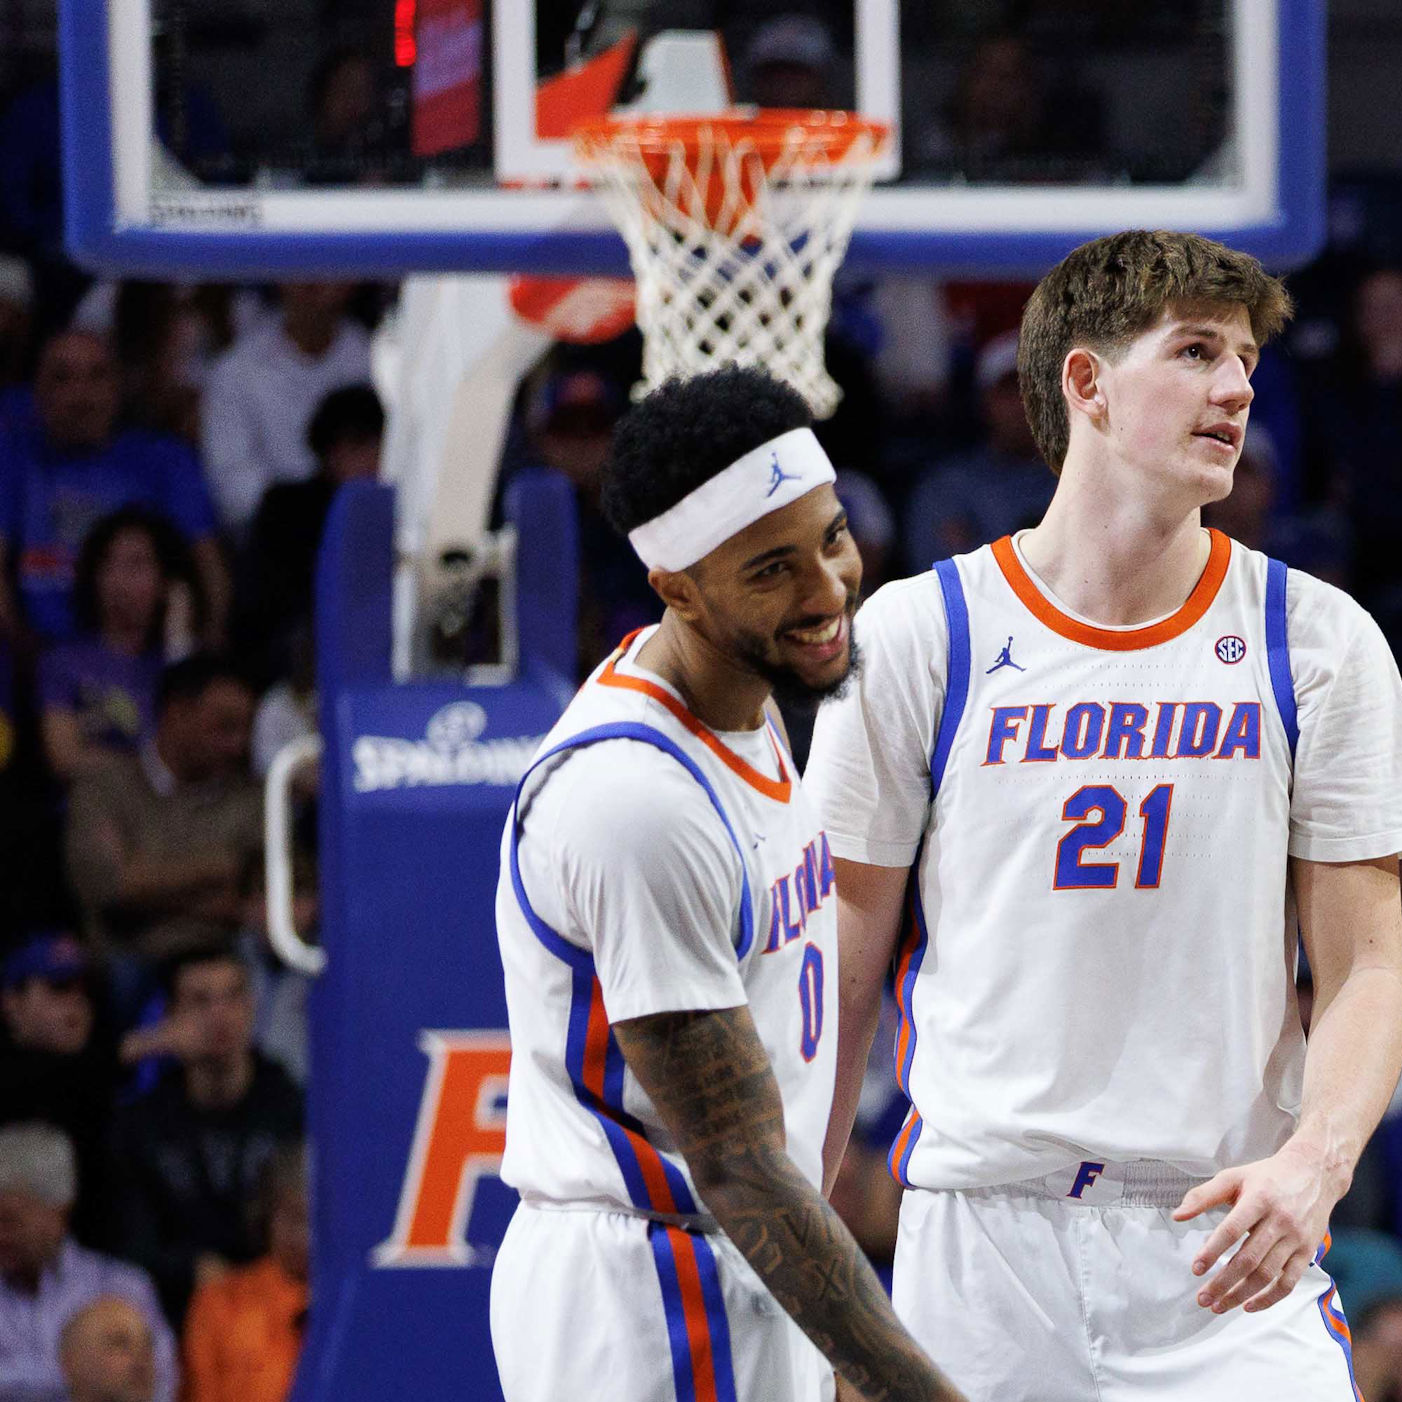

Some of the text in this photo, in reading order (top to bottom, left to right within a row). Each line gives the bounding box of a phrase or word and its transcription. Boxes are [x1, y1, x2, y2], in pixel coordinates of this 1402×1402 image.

[1216, 636, 1245, 664] SEC
[980, 702, 1260, 766] FLORIDA
[1053, 784, 1174, 890] 21
[799, 941, 824, 1063] 0
[1065, 1161, 1105, 1199] F
